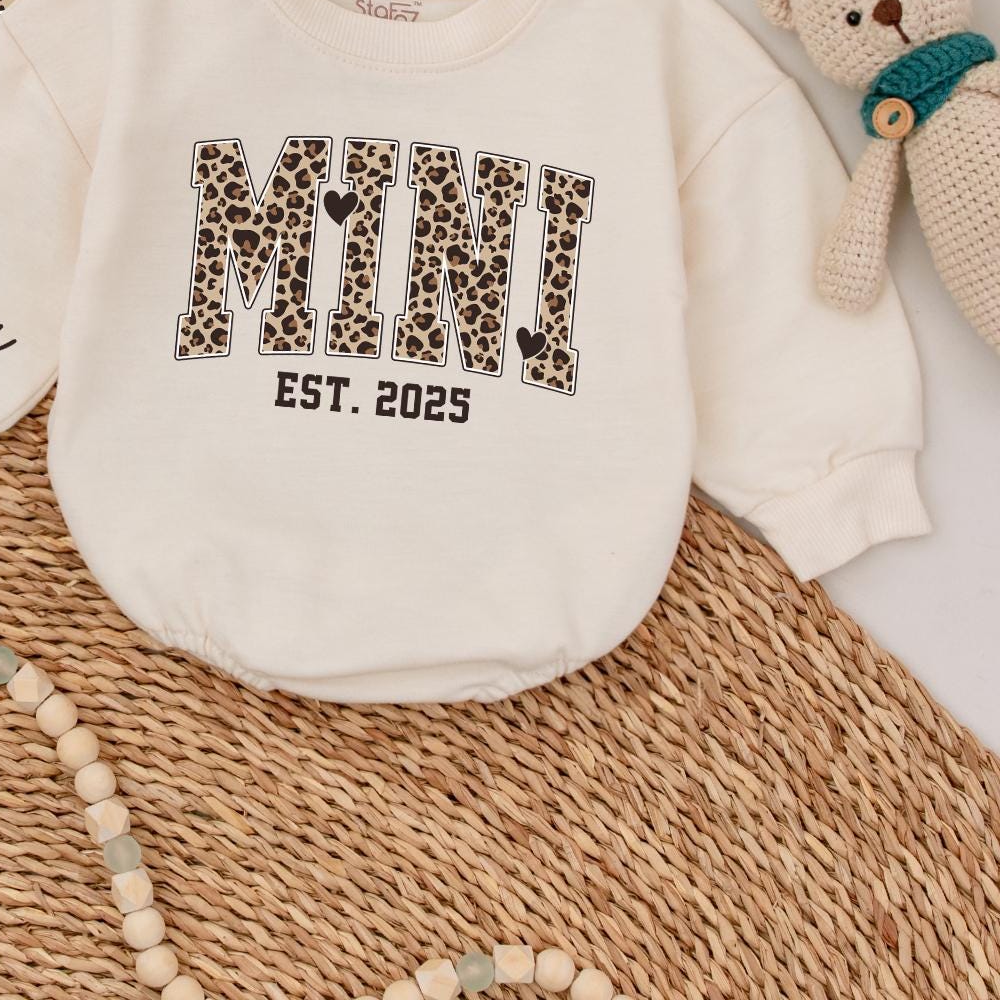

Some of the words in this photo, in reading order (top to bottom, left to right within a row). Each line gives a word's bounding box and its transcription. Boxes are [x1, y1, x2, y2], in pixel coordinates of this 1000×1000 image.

[174, 136, 595, 396] MINI
[274, 371, 360, 414] EST.
[375, 380, 471, 424] 2025
